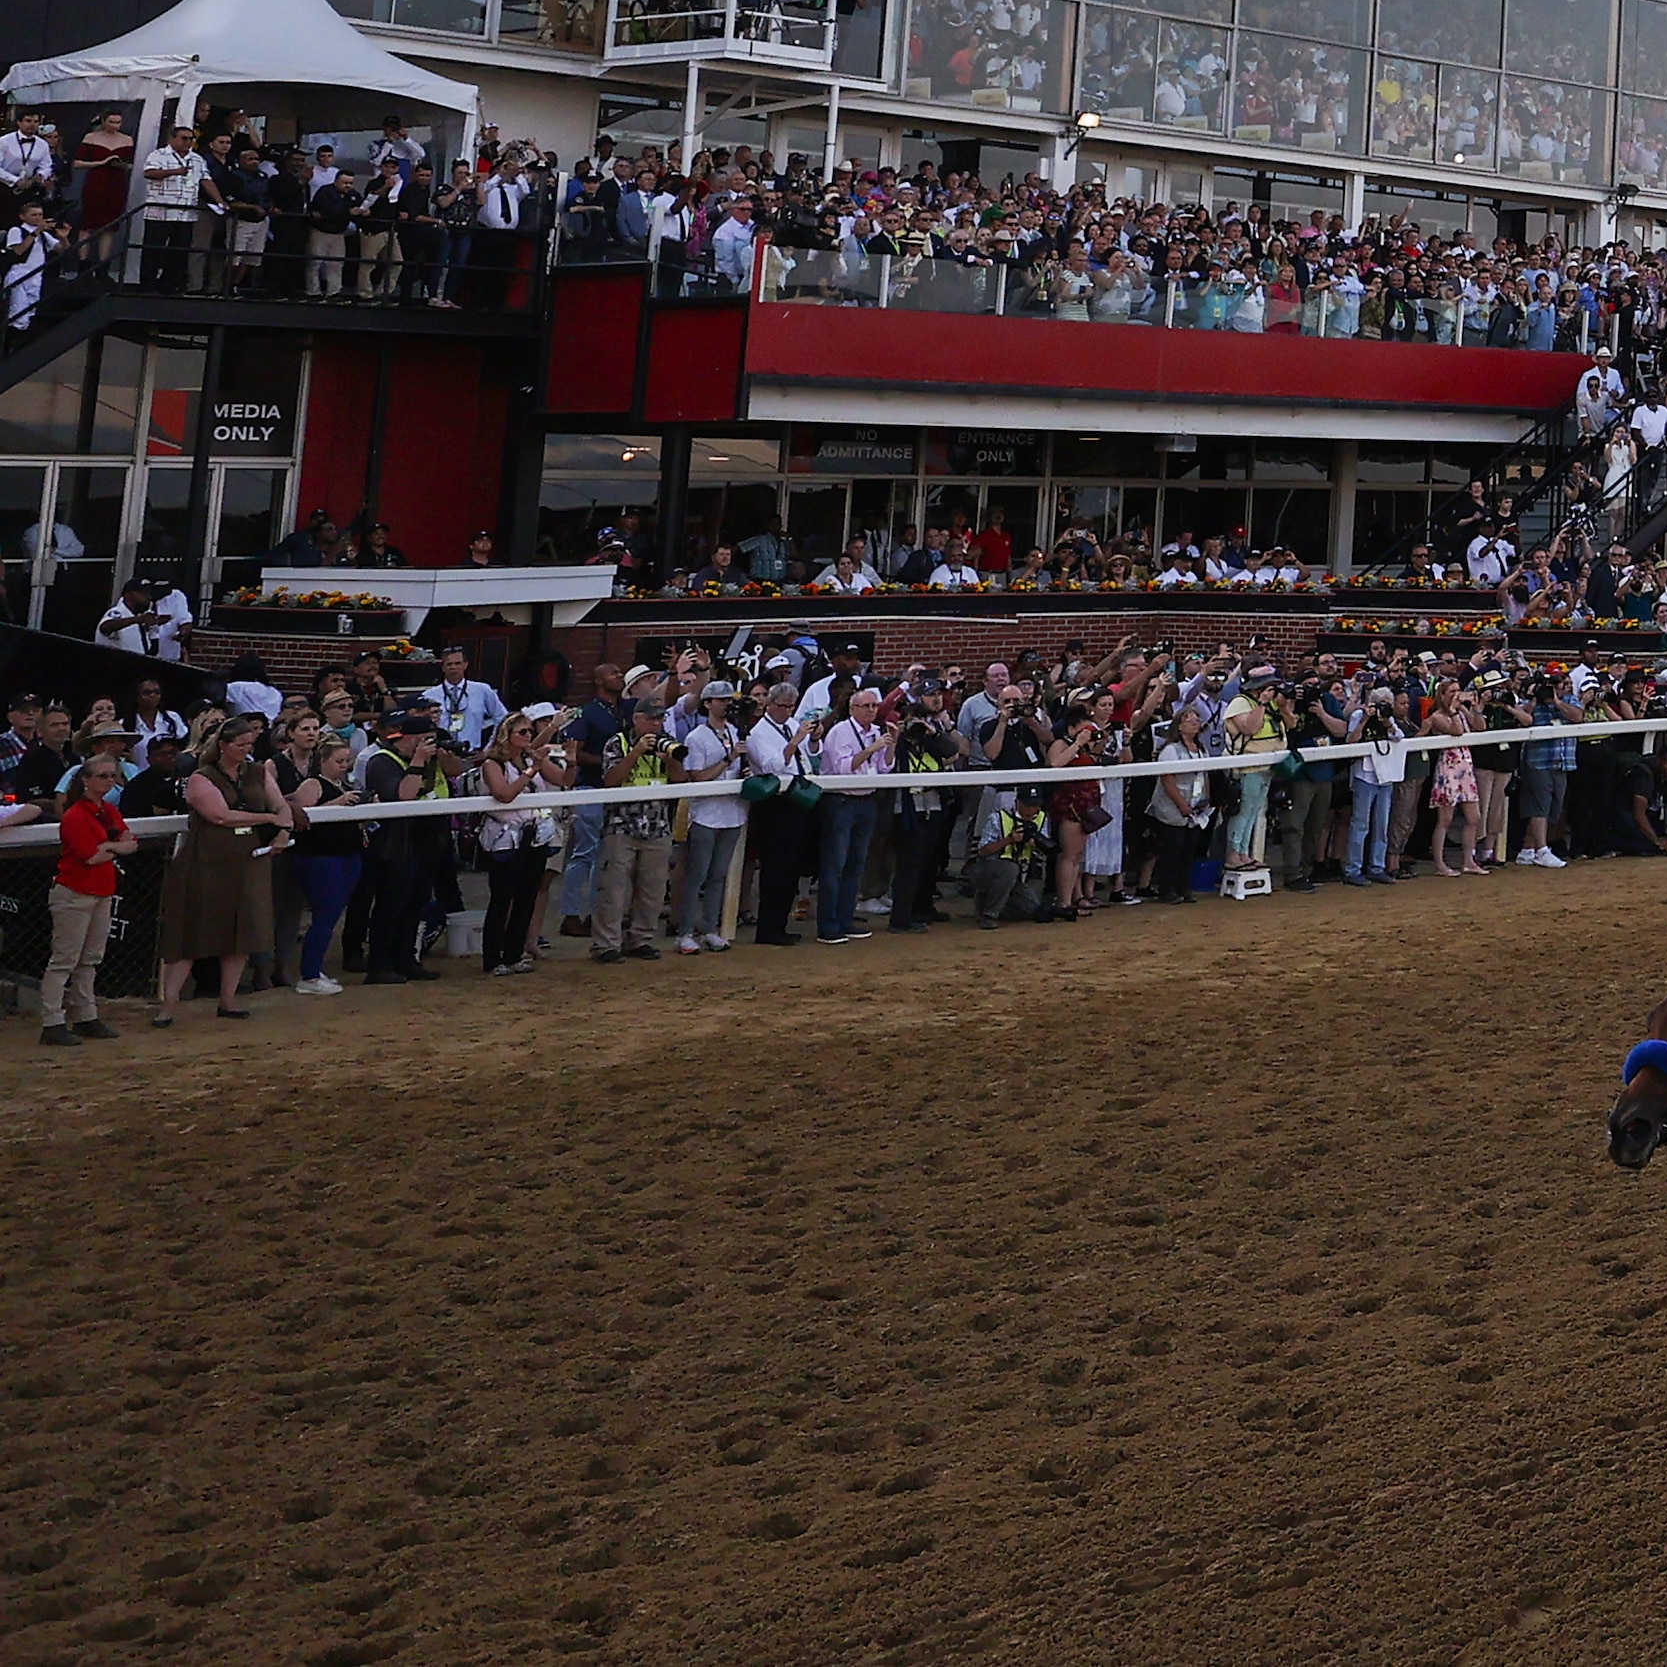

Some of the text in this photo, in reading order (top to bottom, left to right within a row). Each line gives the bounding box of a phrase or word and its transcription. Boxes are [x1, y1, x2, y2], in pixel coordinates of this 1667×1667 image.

[213, 403, 281, 419] MEDIA
[213, 425, 275, 441] ONLY
[855, 429, 878, 441] NO
[957, 431, 1035, 445] ENTRANCE
[816, 446, 913, 460] ADMITTANCE
[976, 449, 1014, 462] ONLY
